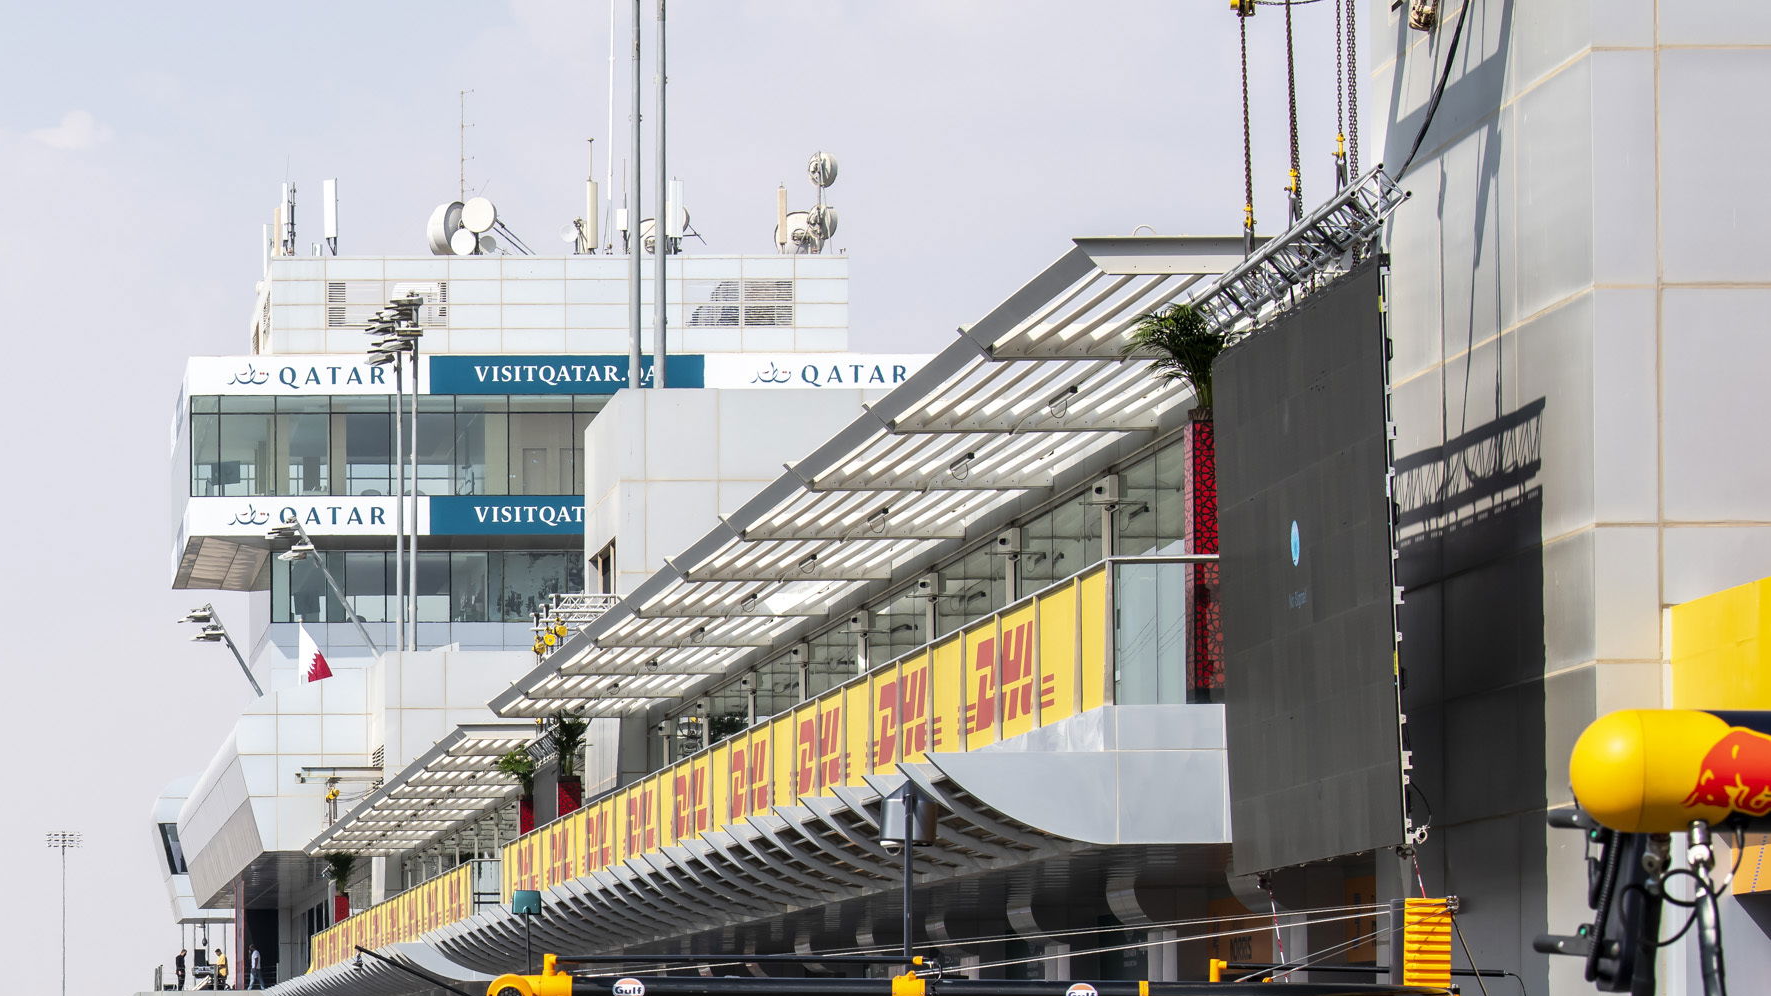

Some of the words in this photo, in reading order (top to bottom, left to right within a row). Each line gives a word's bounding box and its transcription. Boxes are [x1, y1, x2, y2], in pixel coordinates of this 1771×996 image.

[279, 366, 386, 389] QATAR
[801, 365, 907, 387] QATAR
[279, 506, 386, 526] QATAR
[966, 621, 1043, 734] DHL
[872, 667, 934, 767] DHL
[794, 707, 845, 795] DHL
[729, 739, 770, 819] DHL
[615, 985, 642, 995] Gulf
